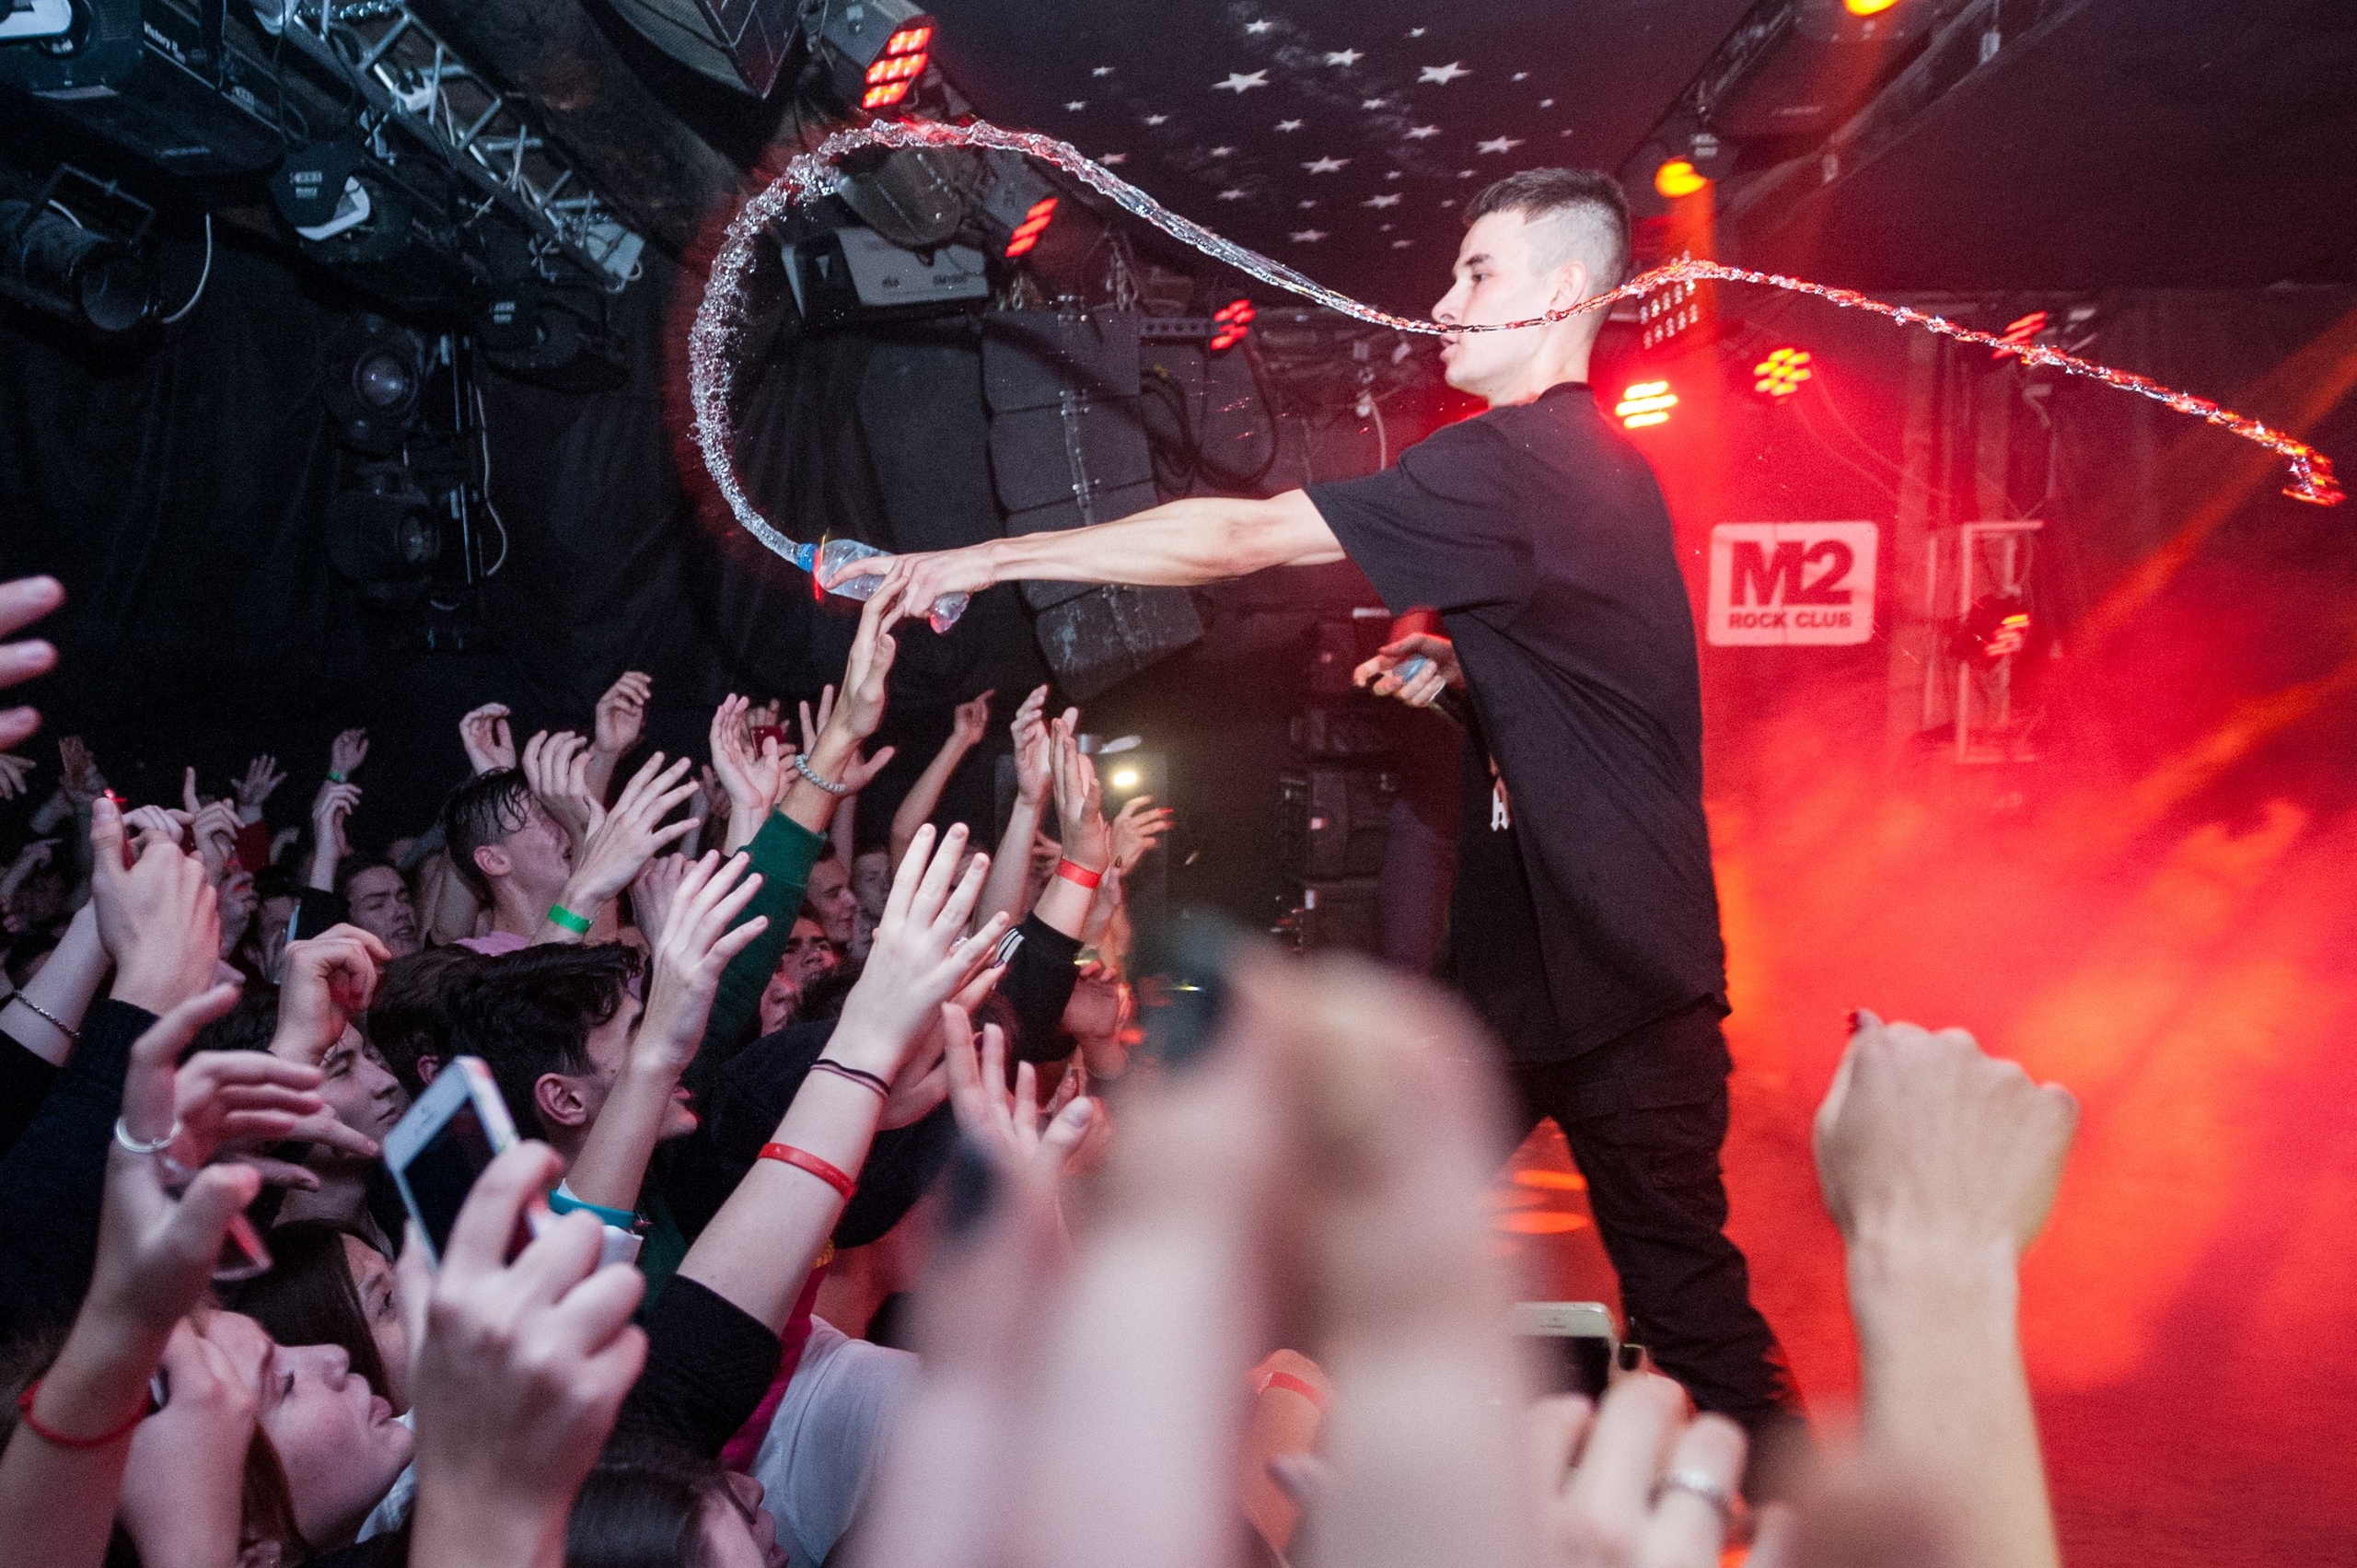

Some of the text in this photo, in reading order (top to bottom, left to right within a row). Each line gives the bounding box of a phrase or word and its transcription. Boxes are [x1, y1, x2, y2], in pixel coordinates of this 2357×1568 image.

[1730, 540, 1852, 607] M2
[1729, 611, 1852, 628] ROCK CLUB
